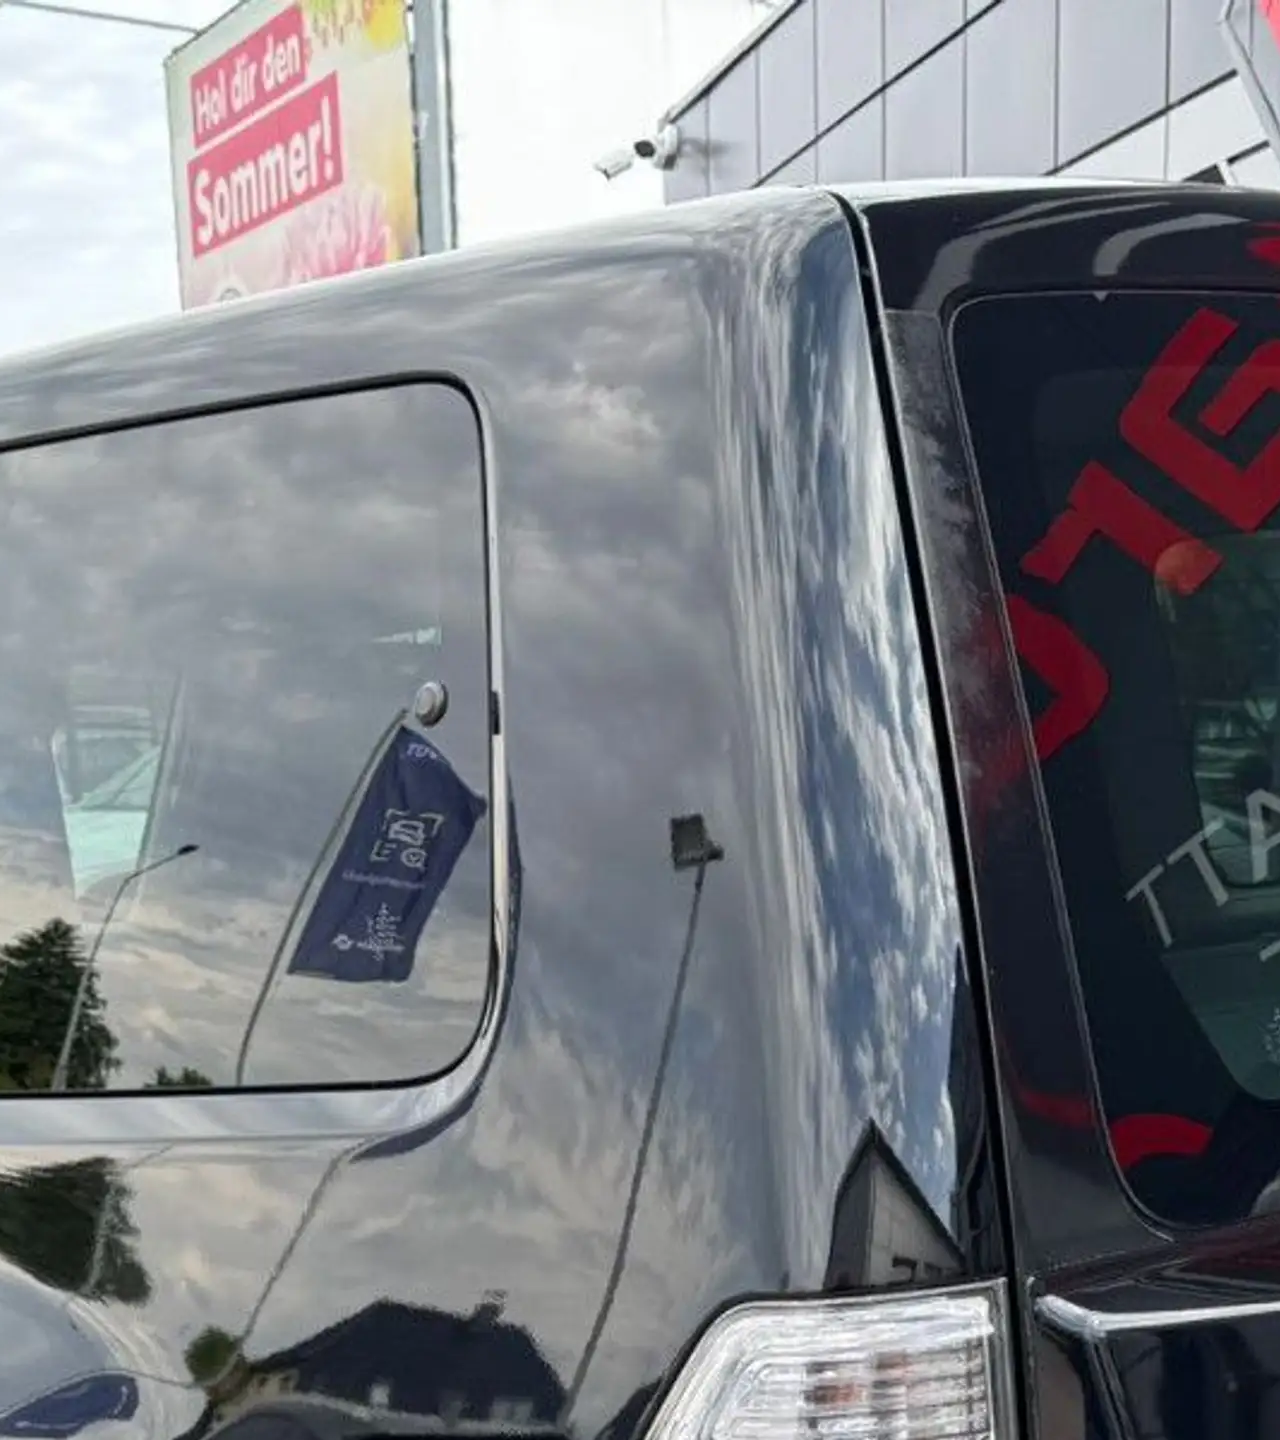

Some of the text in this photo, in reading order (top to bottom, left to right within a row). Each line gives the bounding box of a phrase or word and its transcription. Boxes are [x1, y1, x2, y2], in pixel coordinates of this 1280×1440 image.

[195, 33, 301, 135] Hol dir den
[194, 95, 335, 246] Sommer!
